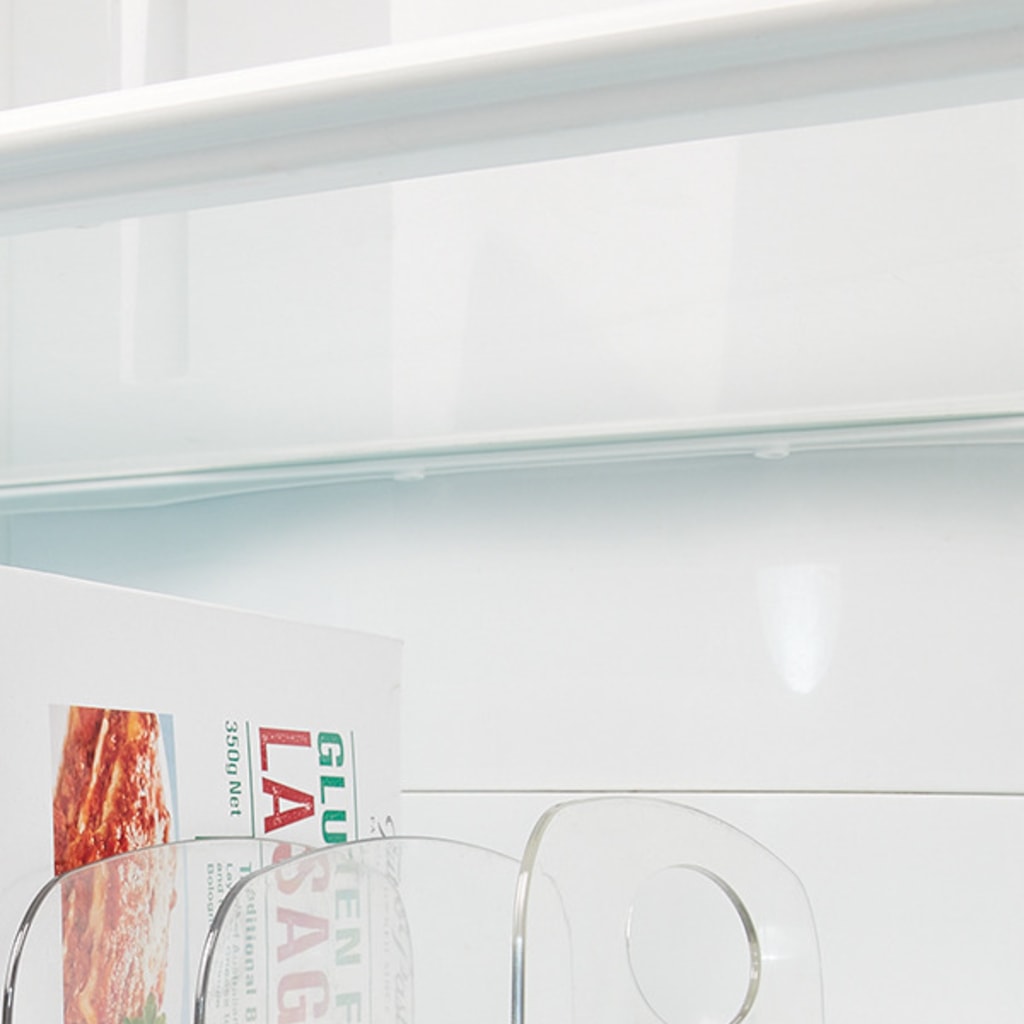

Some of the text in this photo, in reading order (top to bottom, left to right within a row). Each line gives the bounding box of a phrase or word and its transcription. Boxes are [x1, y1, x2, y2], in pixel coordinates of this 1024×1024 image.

[225, 720, 242, 817] 350g Net
[317, 731, 362, 965] GLUTEN
